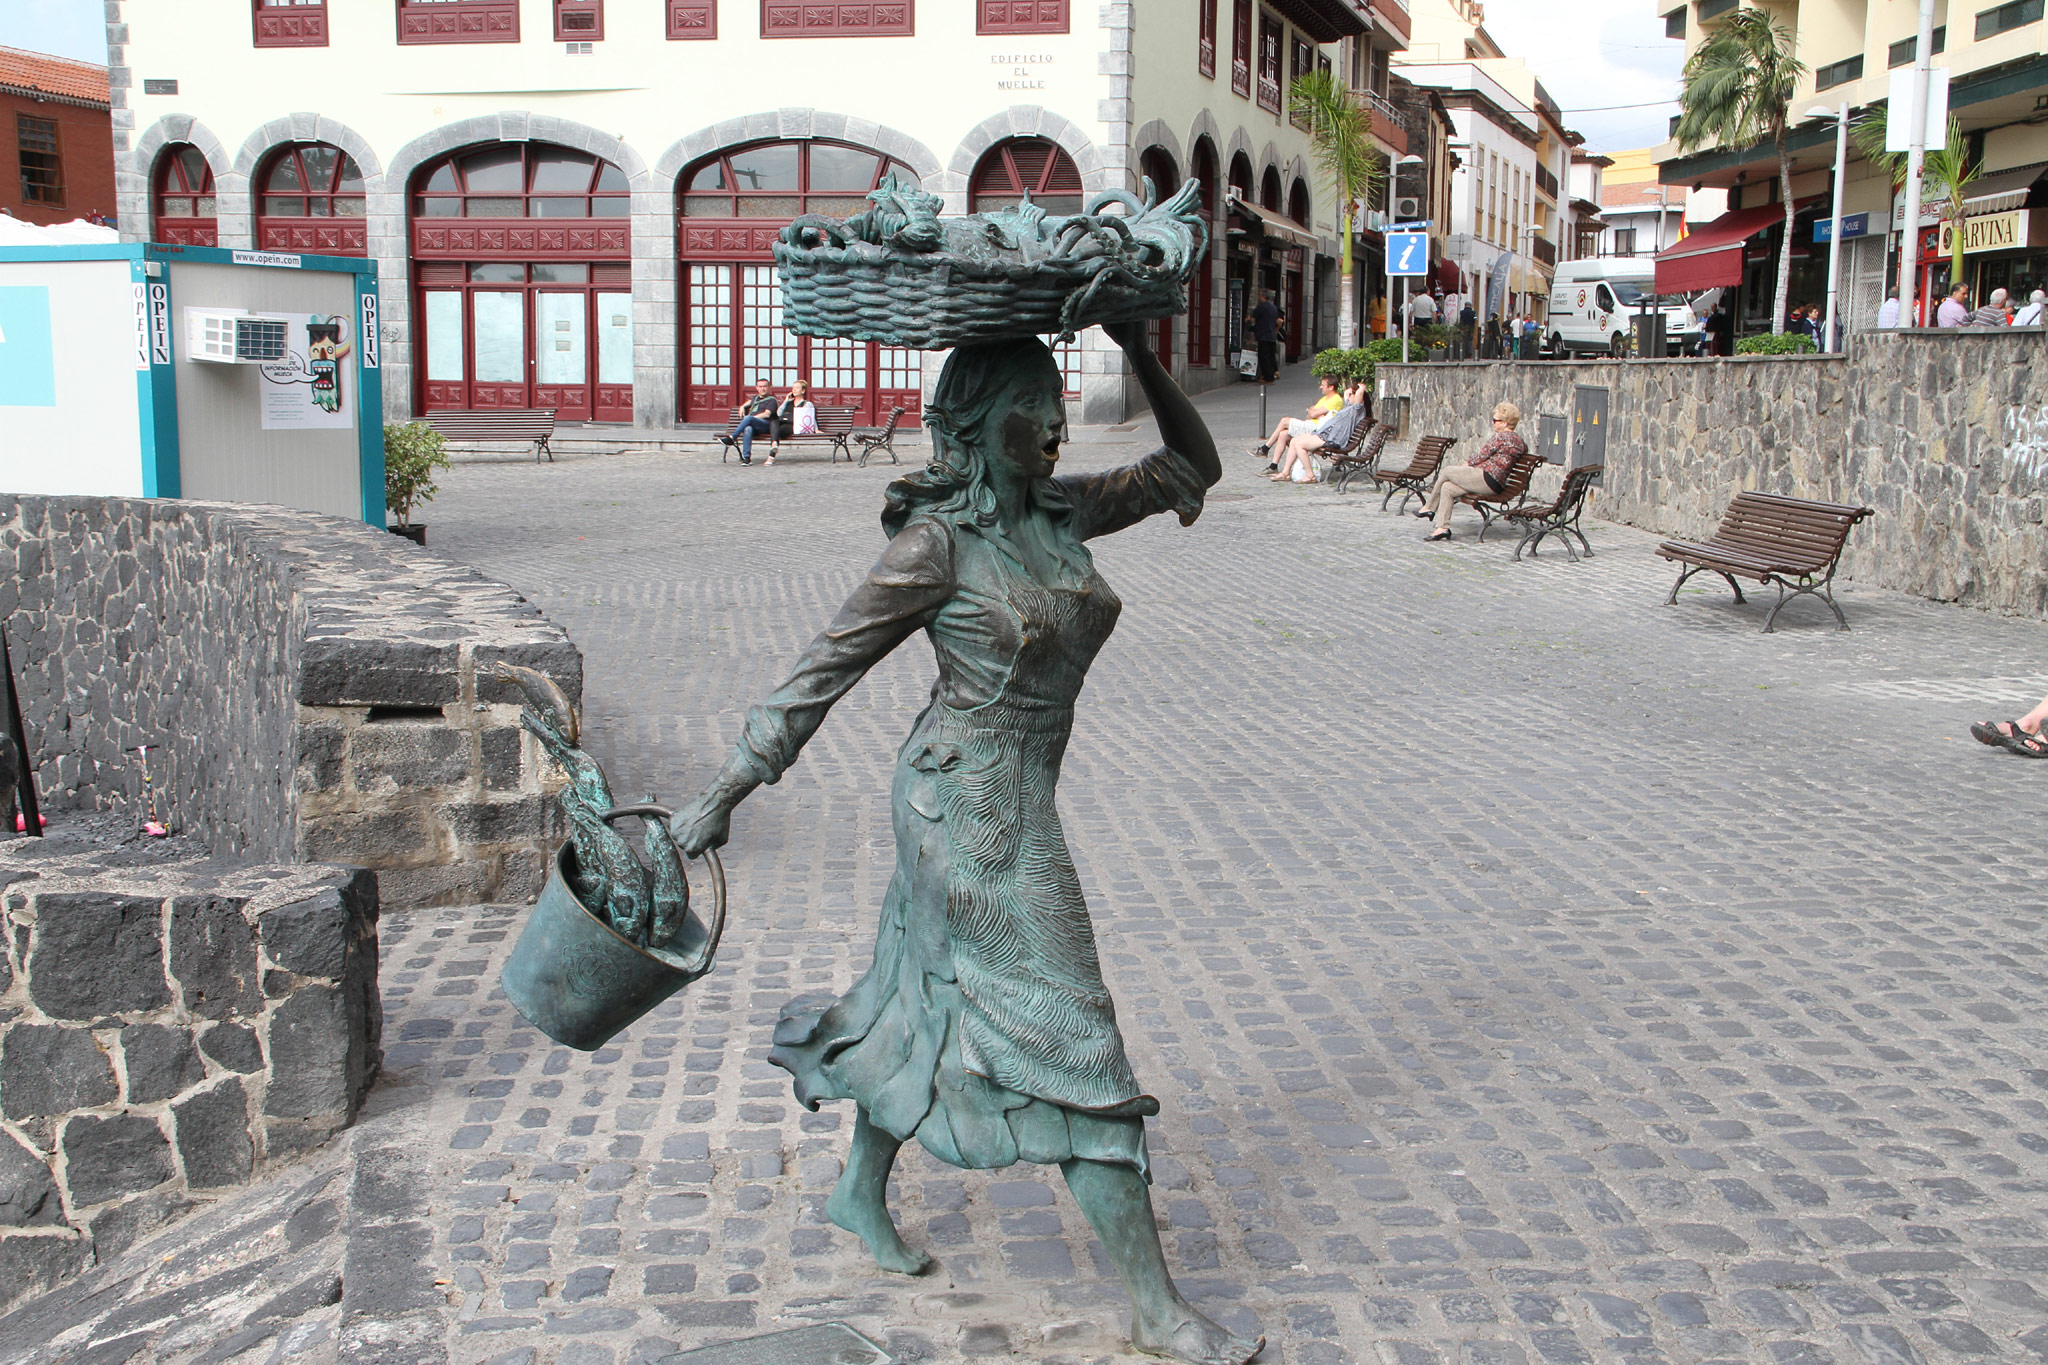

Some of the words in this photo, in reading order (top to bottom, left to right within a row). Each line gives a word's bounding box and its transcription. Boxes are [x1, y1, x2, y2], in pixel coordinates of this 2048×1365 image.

[991, 54, 1053, 64] EDIFICIO
[1014, 67, 1029, 77] EL
[998, 80, 1045, 90] MUELLE
[235, 253, 300, 265] www.opein.com
[1490, 263, 1507, 316] PTICALIA
[134, 285, 147, 363] OPEIN
[152, 285, 169, 363] OPEIN
[364, 296, 376, 367] OPEIN
